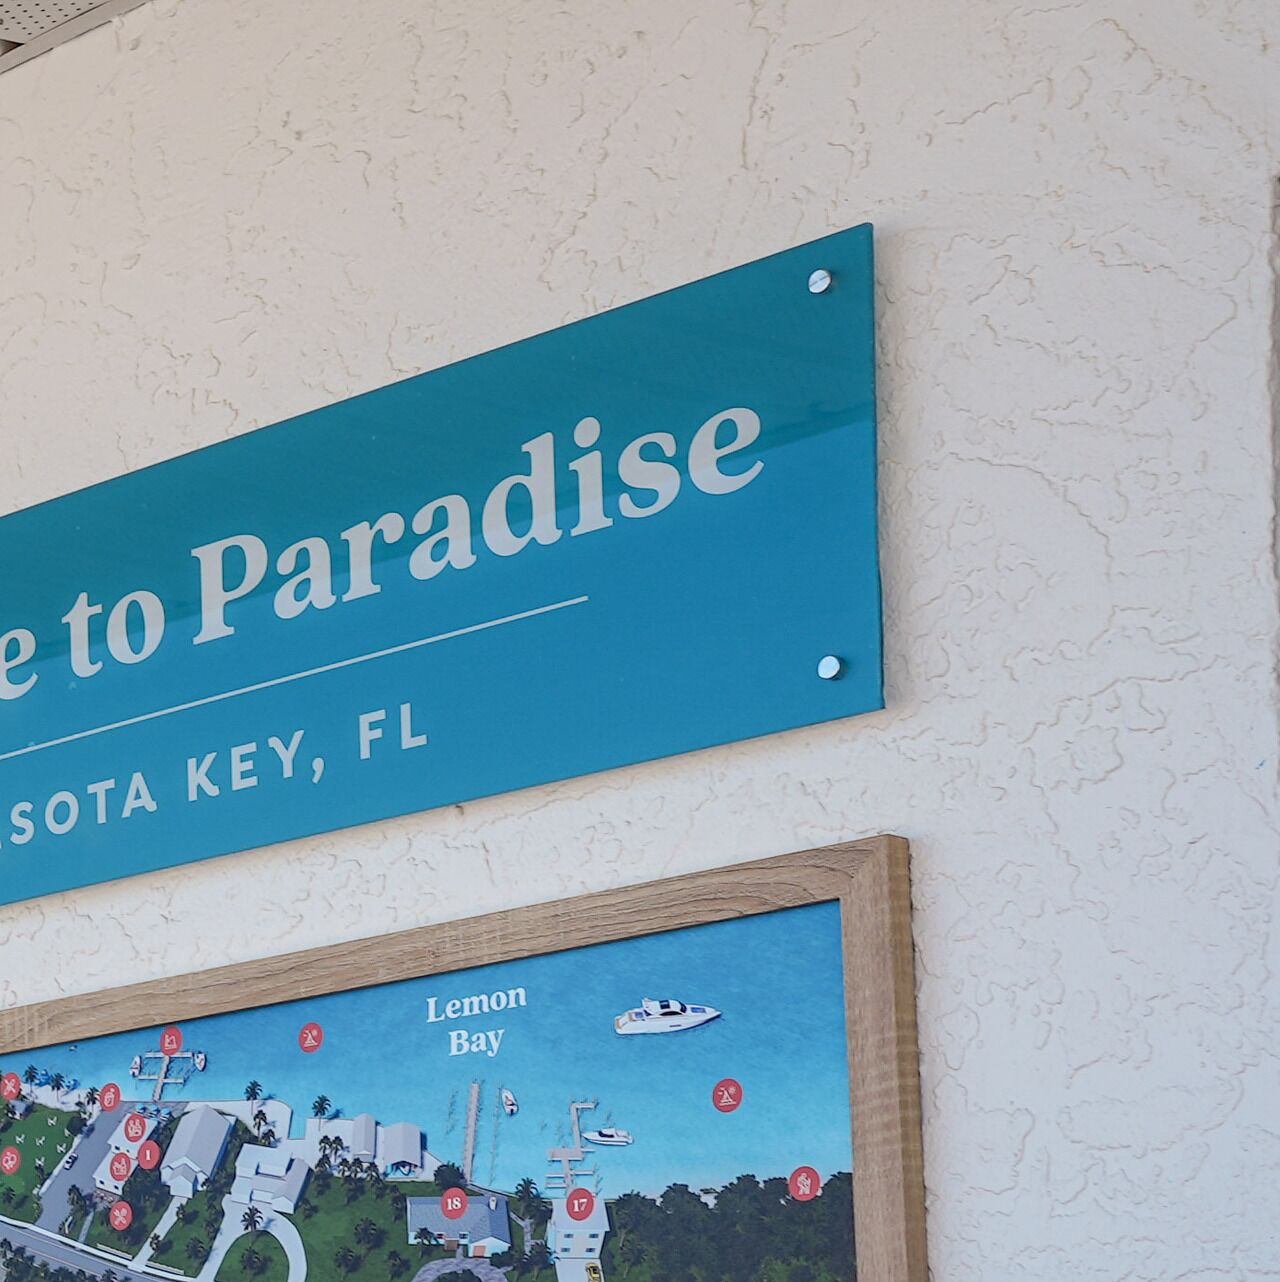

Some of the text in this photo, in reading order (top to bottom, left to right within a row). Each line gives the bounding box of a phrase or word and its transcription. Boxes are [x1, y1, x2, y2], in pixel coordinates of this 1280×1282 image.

[61, 591, 167, 678] to
[191, 407, 765, 645] Paradise
[187, 730, 326, 803] KEY,
[359, 702, 428, 760] FL
[425, 986, 527, 1023] Lemon
[448, 1028, 505, 1058] Bay
[447, 1197, 462, 1211] 18
[573, 1198, 588, 1212] 17
